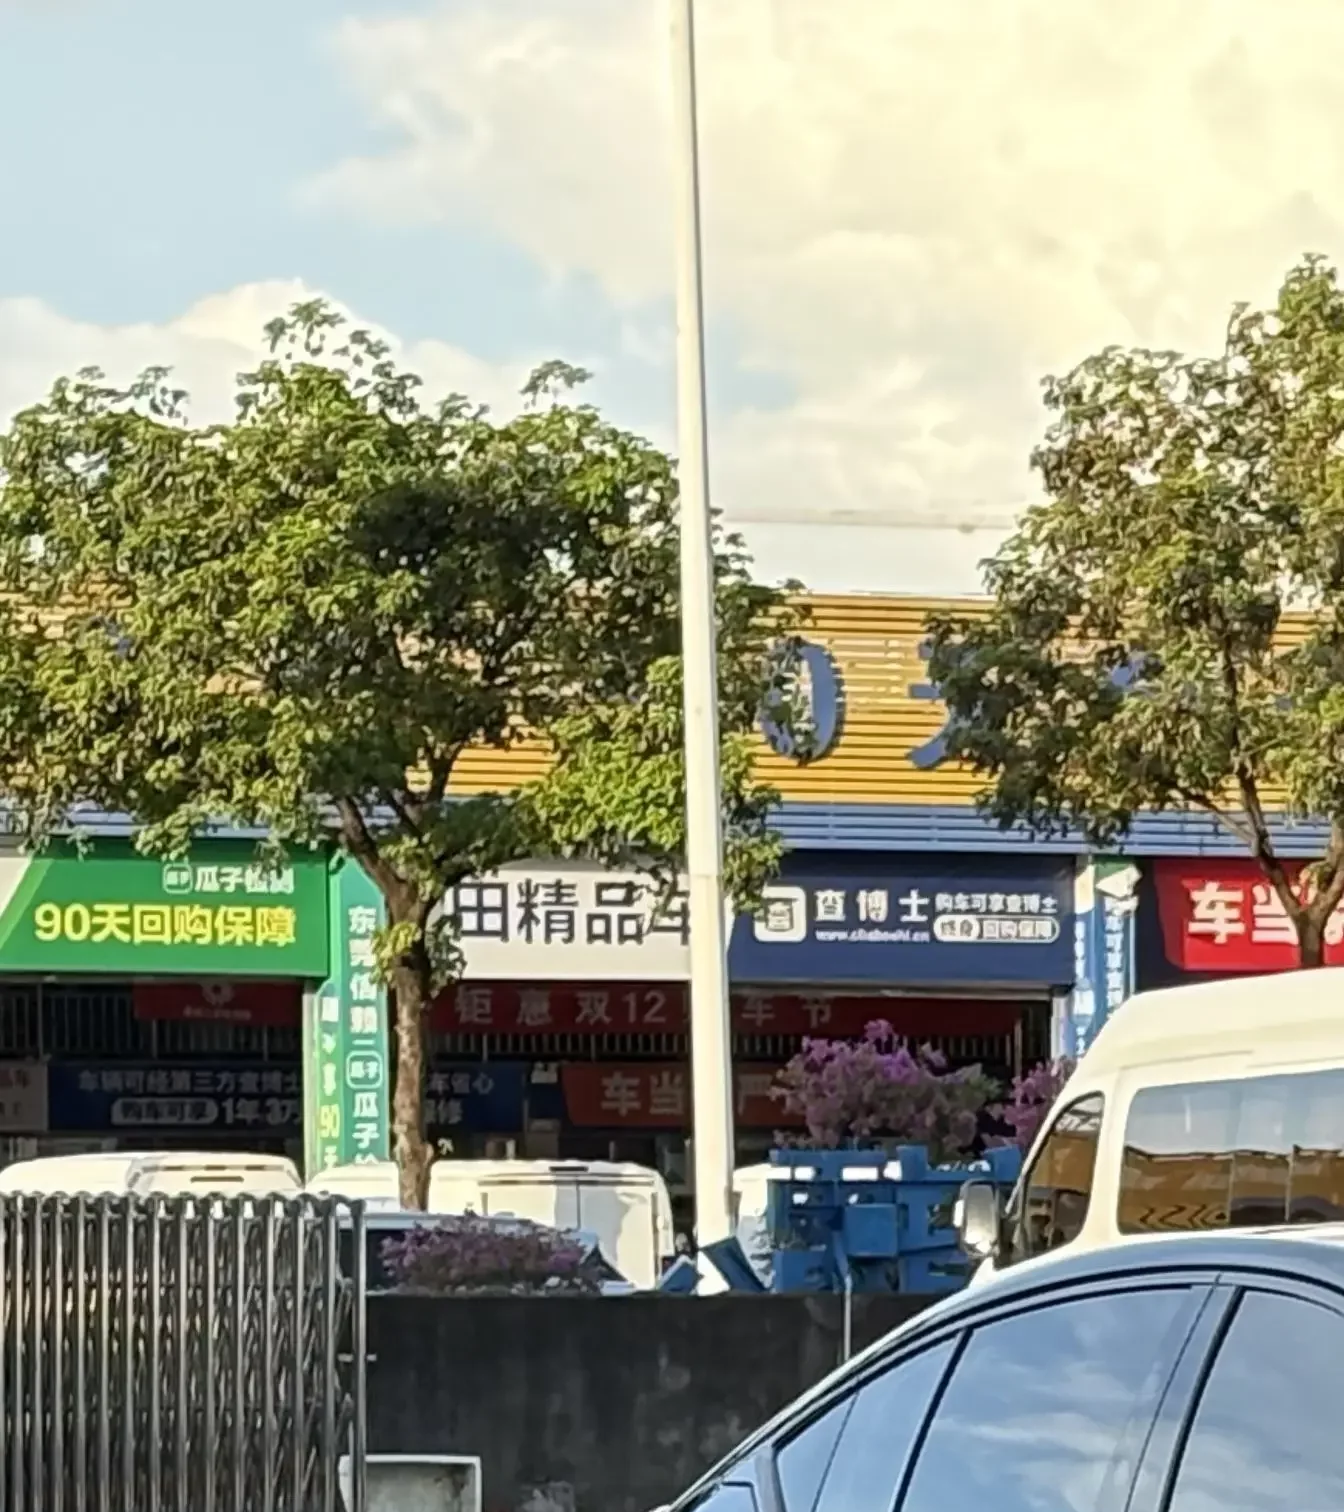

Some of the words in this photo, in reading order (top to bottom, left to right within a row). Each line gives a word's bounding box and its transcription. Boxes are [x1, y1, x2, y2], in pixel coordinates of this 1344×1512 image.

[34, 903, 296, 947] 90天回购保障
[814, 888, 930, 923] 查博士
